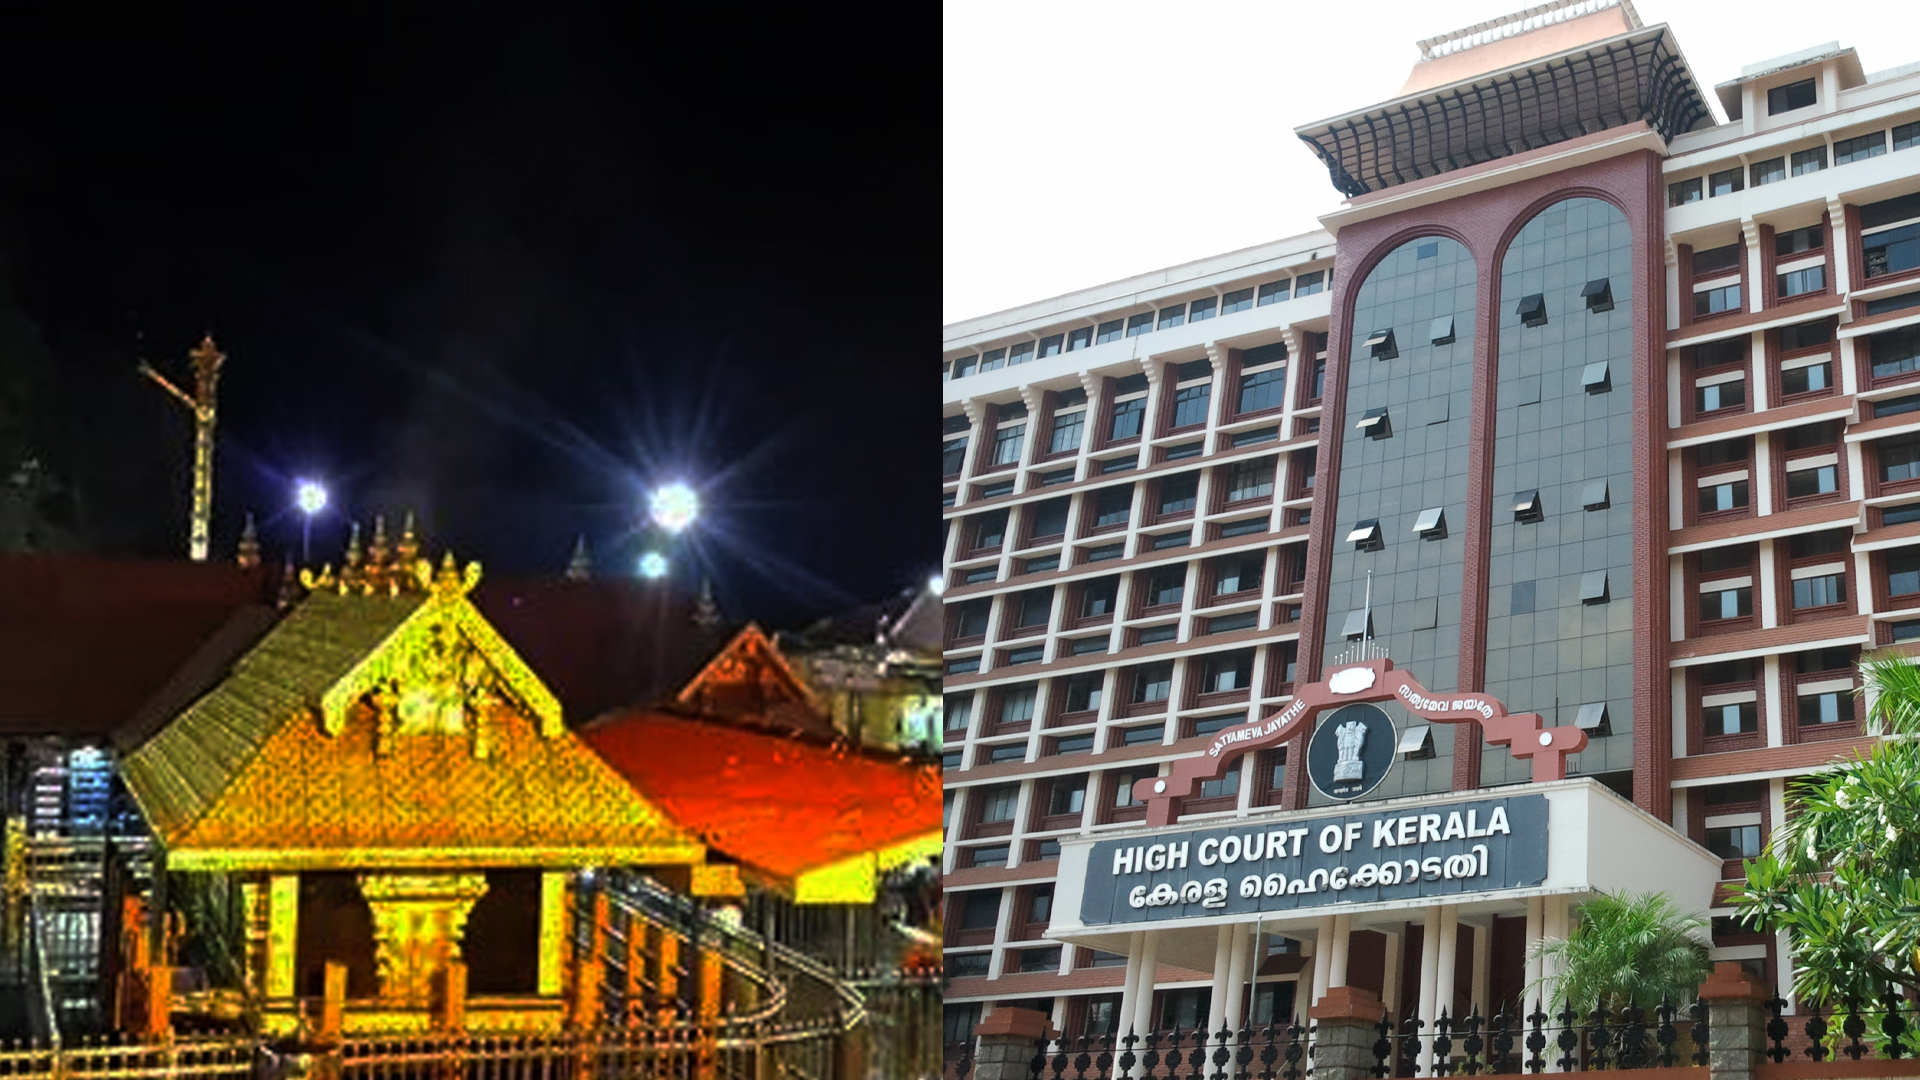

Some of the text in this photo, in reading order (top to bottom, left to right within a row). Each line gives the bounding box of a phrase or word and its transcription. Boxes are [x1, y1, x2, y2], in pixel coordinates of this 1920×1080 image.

[1209, 698, 1306, 757] SATYAMEVA JAYATHE
[1398, 684, 1494, 720] സത്യമേവ ജയതേ
[1112, 806, 1511, 875] HIGH COURT OF KERALA
[1128, 844, 1489, 909] കേരള ഹൈക്കോടതി
